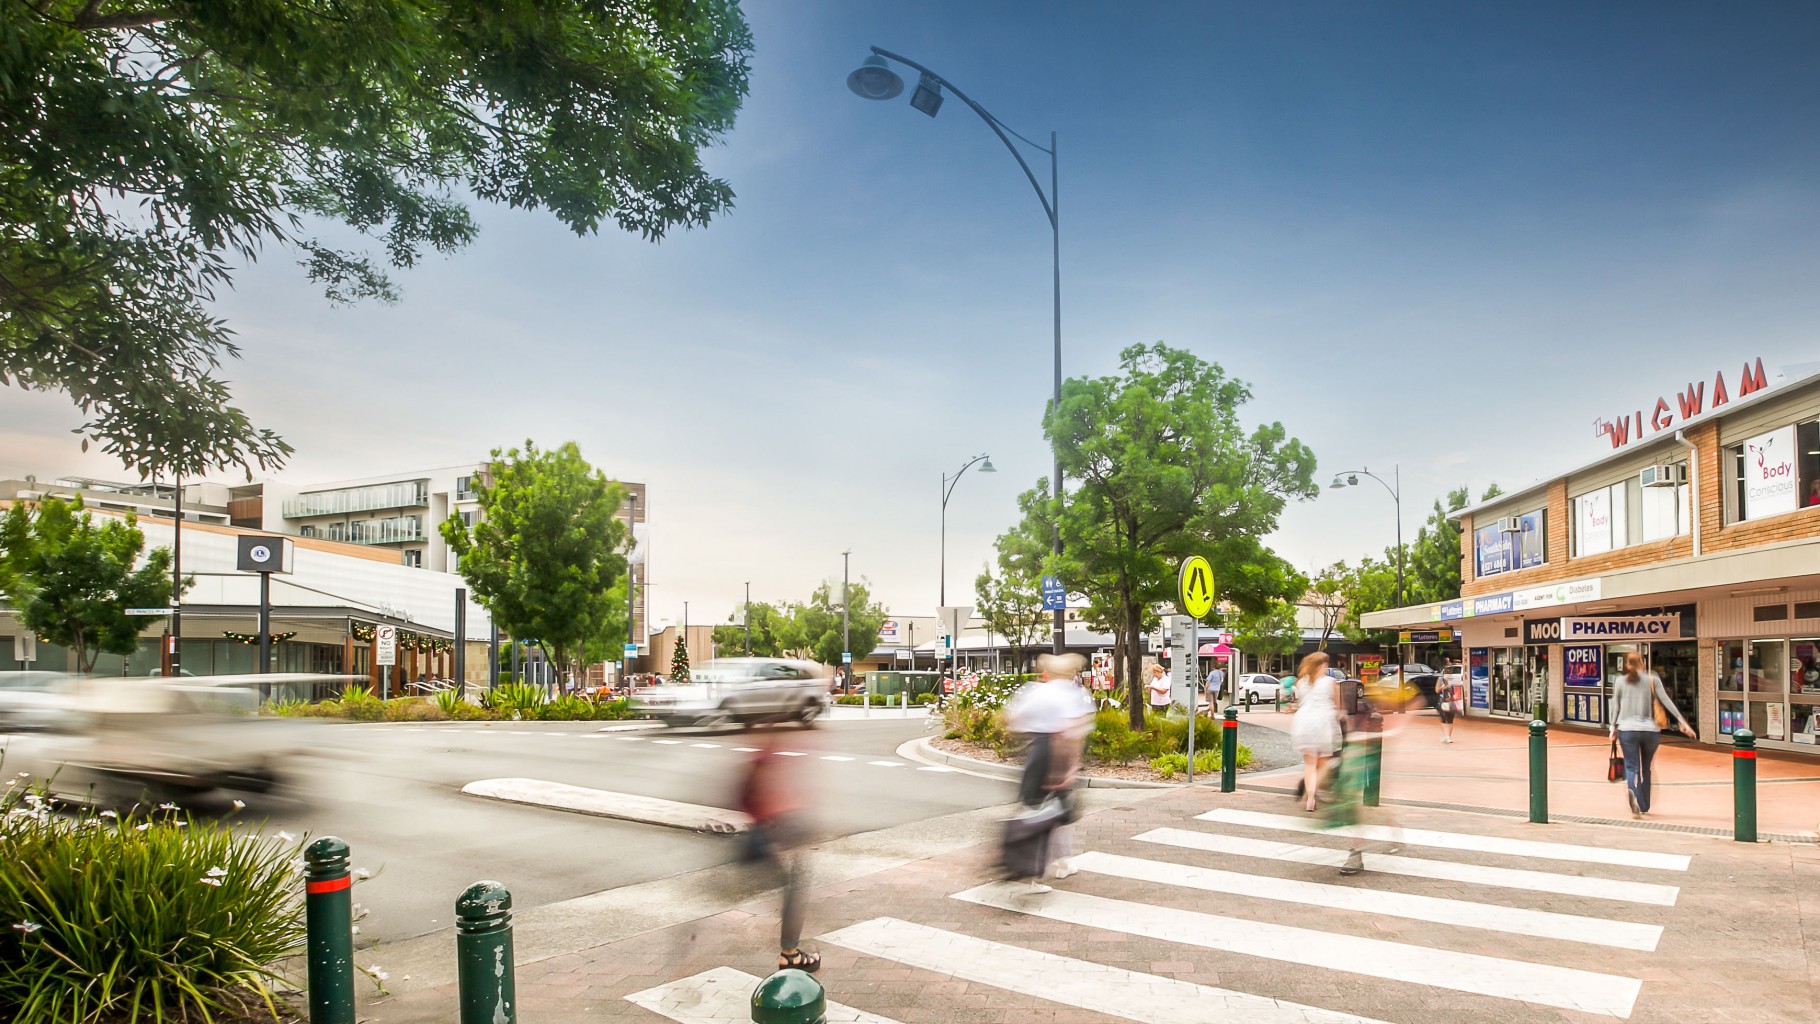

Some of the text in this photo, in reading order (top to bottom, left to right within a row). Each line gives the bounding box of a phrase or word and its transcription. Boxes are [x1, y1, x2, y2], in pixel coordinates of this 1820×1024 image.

[1609, 357, 1768, 449] WIGWAM
[1763, 462, 1792, 479] Body
[1749, 481, 1793, 499] Conscious
[1592, 515, 1608, 527] Body
[1475, 595, 1512, 614] PHARMACY
[1569, 584, 1594, 594] Diabetes
[1572, 620, 1671, 635] PHARMACY
[1568, 648, 1597, 662] OPEN
[1569, 663, 1597, 676] 7 DAYS
